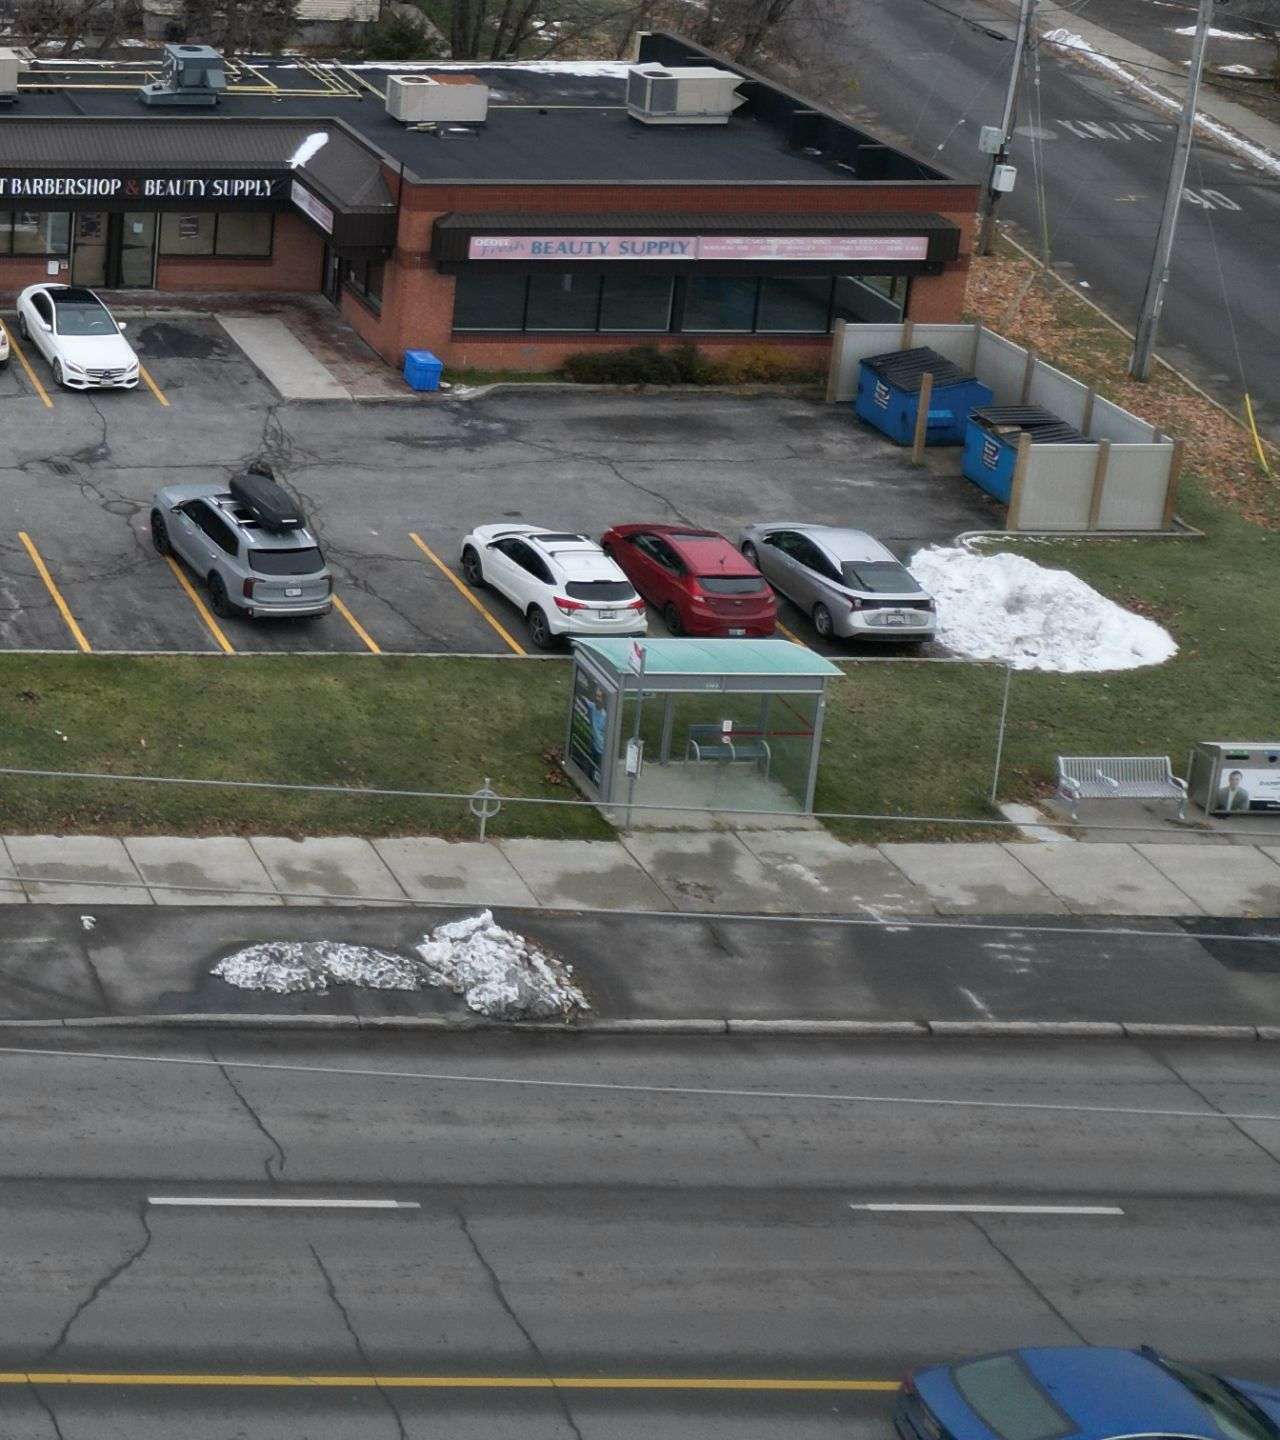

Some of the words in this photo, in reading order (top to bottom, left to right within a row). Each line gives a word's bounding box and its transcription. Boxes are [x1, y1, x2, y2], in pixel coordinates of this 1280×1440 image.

[11, 177, 122, 195] BARBERSHOP
[125, 178, 139, 195] &
[145, 179, 209, 196] BEAUTY
[212, 179, 276, 196] SUPPLY
[530, 240, 610, 256] BEAUTY
[618, 241, 690, 256] SUPPLY
